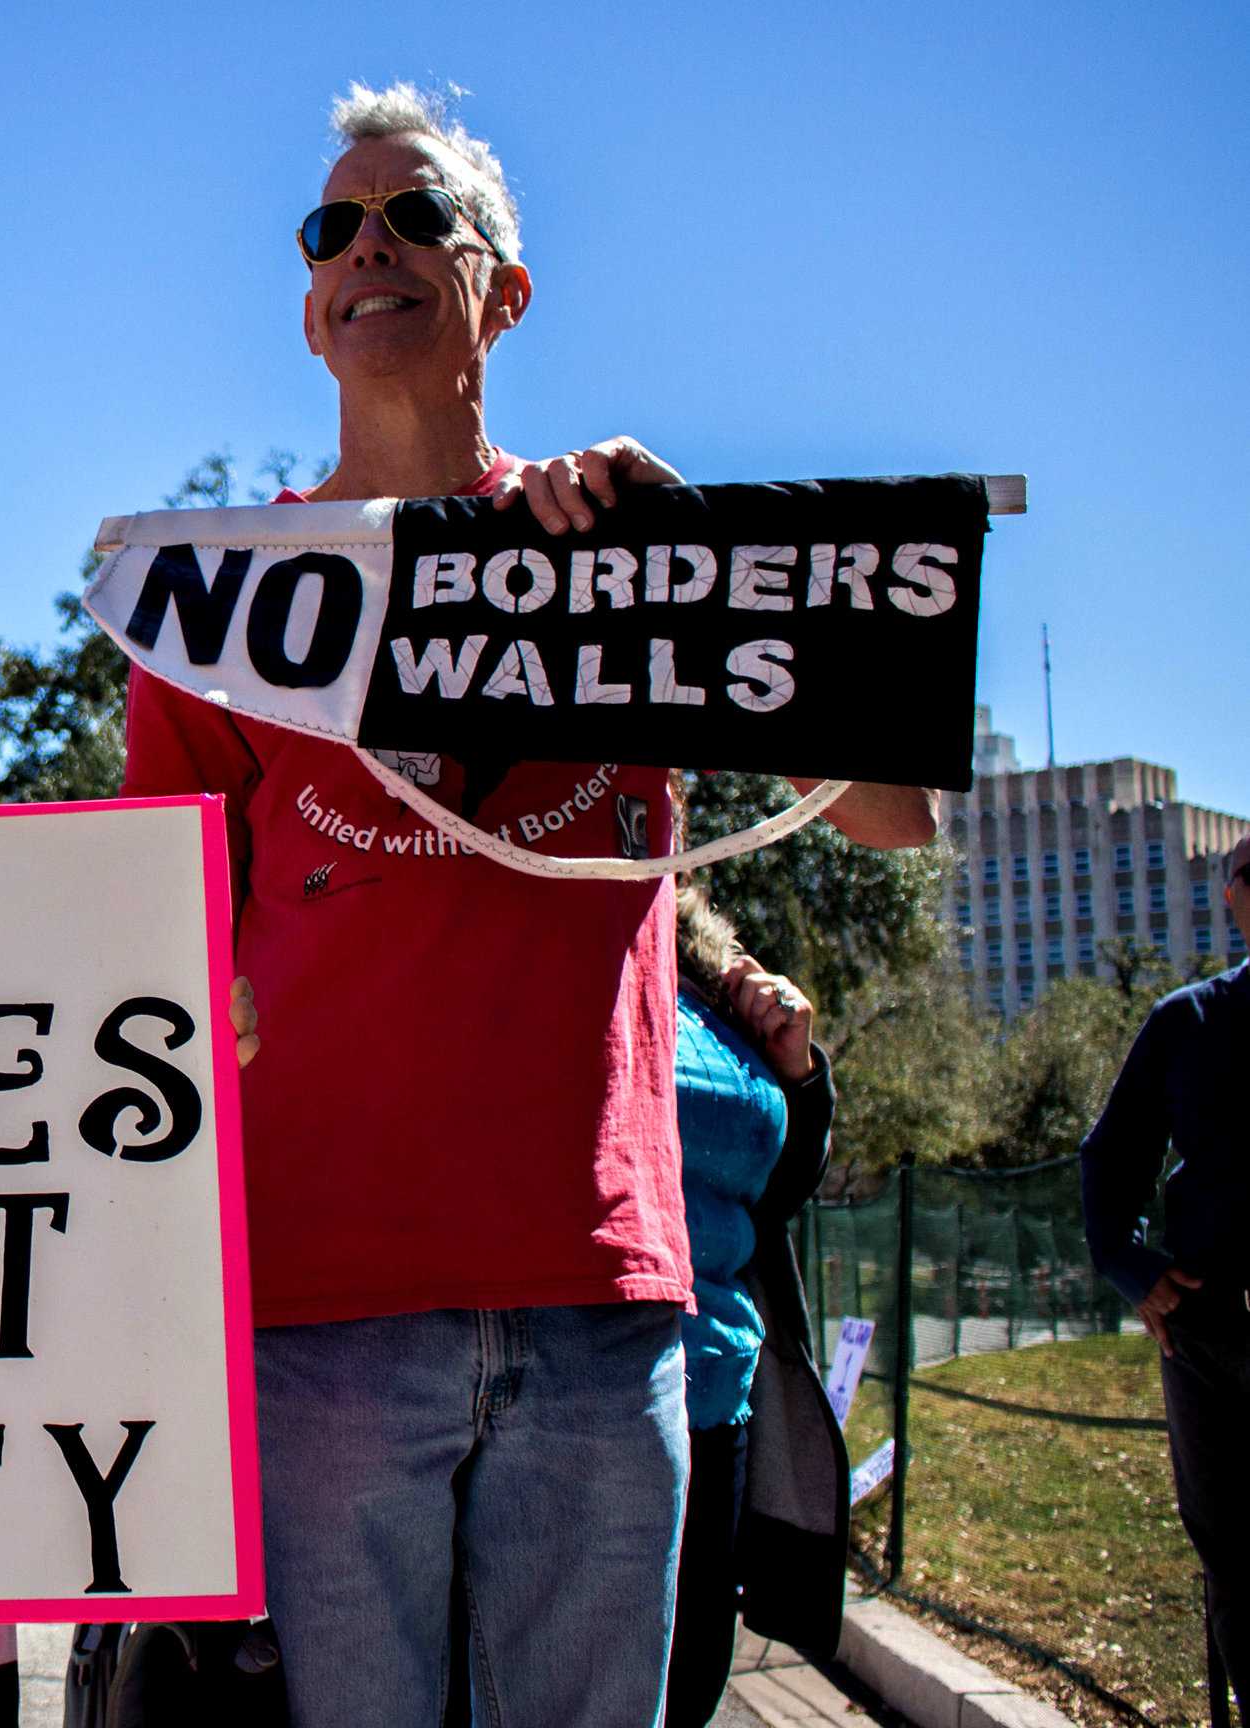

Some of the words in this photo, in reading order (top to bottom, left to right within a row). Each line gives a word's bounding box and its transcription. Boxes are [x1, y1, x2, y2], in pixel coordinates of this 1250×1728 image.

[124, 543, 364, 689] NO
[412, 542, 959, 617] BORDERS
[389, 634, 796, 713] WALLS
[296, 783, 379, 852] United
[383, 824, 512, 857] witht
